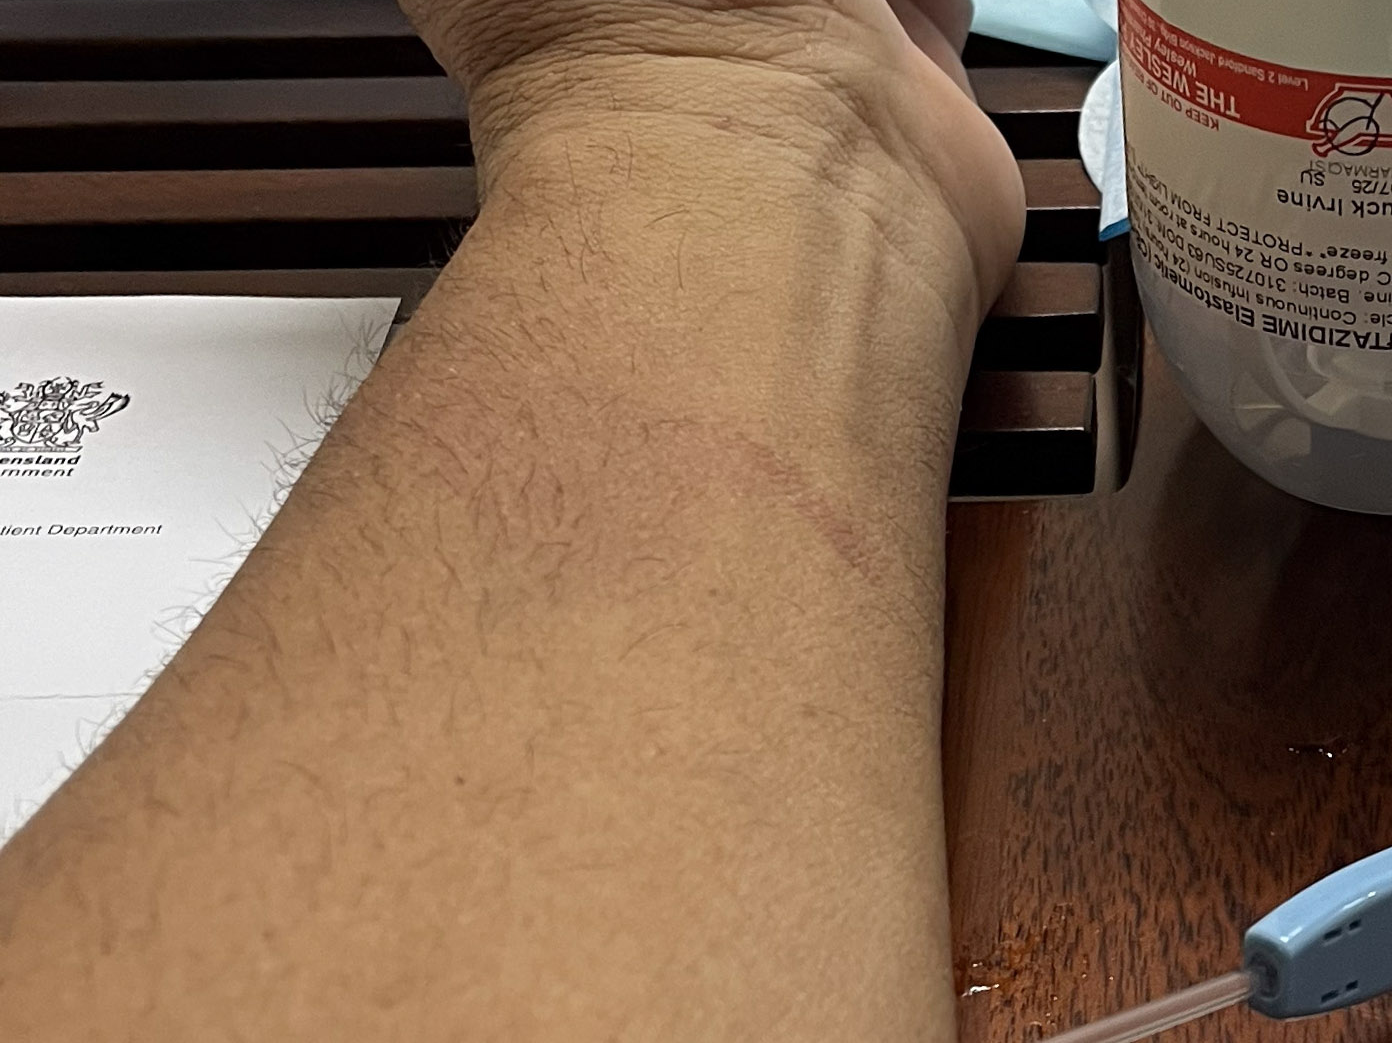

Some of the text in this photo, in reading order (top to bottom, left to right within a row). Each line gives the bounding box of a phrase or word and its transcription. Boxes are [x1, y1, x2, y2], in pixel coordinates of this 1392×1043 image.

[1130, 32, 1191, 98] WESLEY
[1154, 37, 1197, 79] Wesley
[1268, 71, 1276, 83] 2
[1161, 89, 1182, 112] OUT
[1195, 80, 1241, 119] THE
[1185, 108, 1220, 132] KEEP
[1300, 170, 1326, 187] SU
[1170, 192, 1211, 227] FROM
[1277, 188, 1342, 216] Irvine
[1175, 216, 1188, 231] at
[1190, 223, 1231, 255] hours
[1235, 244, 1254, 263] 24
[1260, 252, 1288, 272] OR
[1194, 267, 1250, 302] Infusion
[1293, 261, 1370, 284] degrees
[1154, 254, 1255, 327] Elastomeric
[1293, 280, 1351, 304] Batch:
[1255, 293, 1357, 325] Continuous
[47, 524, 164, 537] Department
